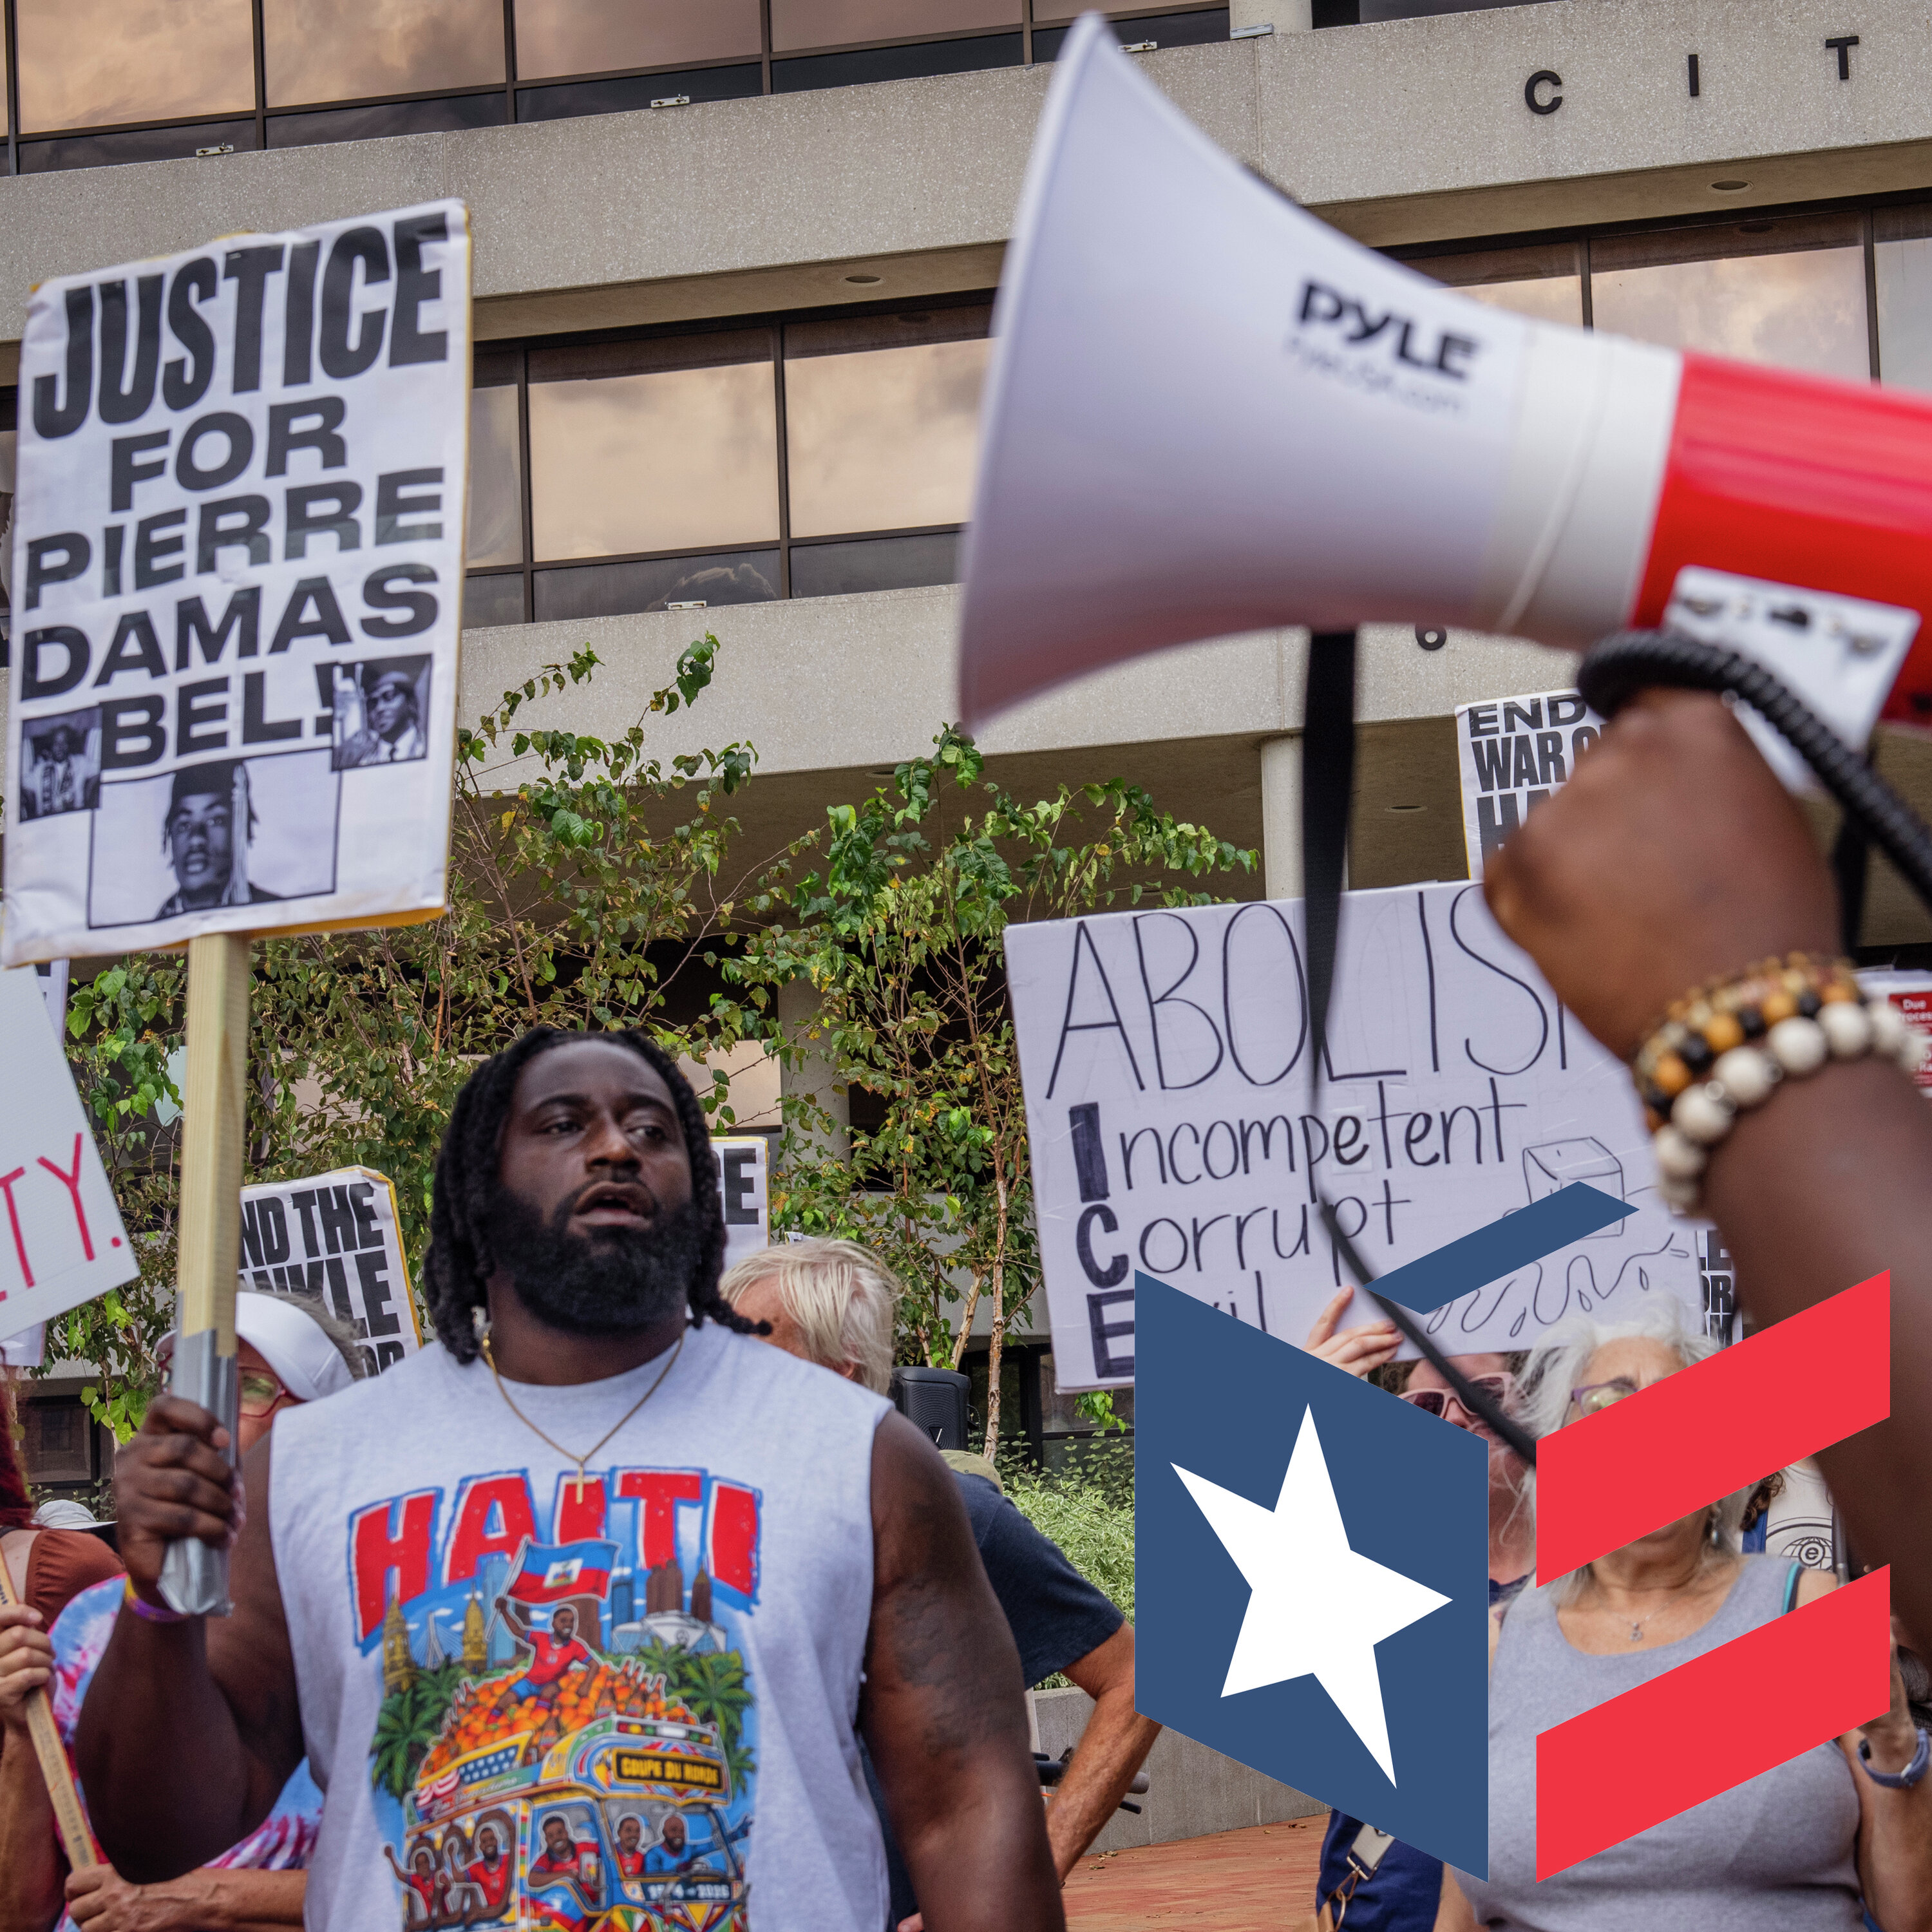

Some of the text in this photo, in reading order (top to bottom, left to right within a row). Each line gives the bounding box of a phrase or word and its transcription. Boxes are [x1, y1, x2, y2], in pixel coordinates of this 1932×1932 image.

[33, 211, 448, 439] JUSTICE
[111, 395, 347, 513] FOR
[24, 467, 444, 612] PIERRE
[20, 562, 439, 703] DAMAS
[1468, 694, 1587, 738] END
[1472, 730, 1567, 792] WAR
[1046, 883, 1566, 1099] ABOLIS
[1069, 1077, 1527, 1203] Incompetent
[241, 1182, 385, 1270] ND THE
[1076, 1179, 1412, 1288] Corrupt
[346, 1466, 762, 1655] HAITI
[620, 1757, 663, 1777] COUPE
[664, 1761, 682, 1779] DU
